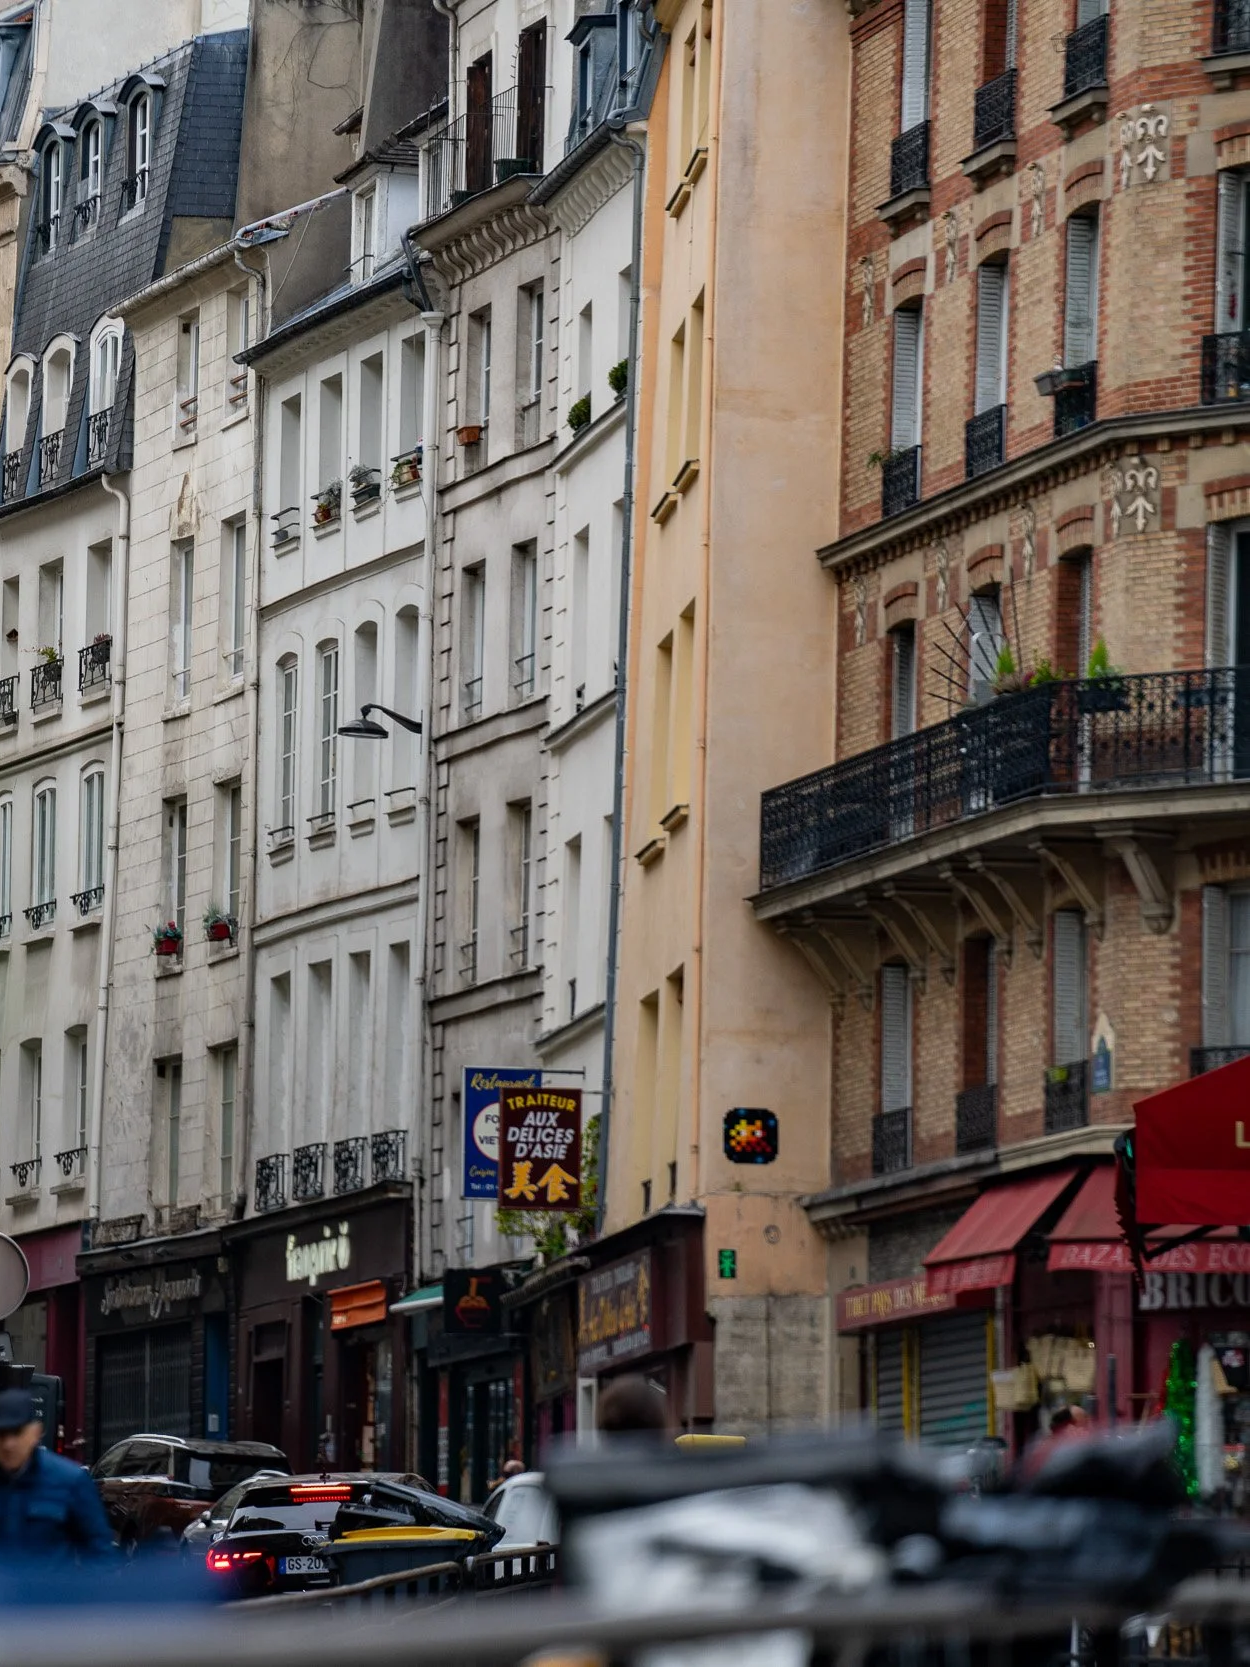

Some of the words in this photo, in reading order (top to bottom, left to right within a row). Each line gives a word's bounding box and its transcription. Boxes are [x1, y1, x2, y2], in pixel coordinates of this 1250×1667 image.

[507, 1093, 576, 1112] TRAITEUR
[523, 1111, 560, 1127] AUX
[515, 1142, 568, 1160] D'ASIE
[503, 1160, 579, 1202] 美食
[1059, 1244, 1133, 1267] BAZA
